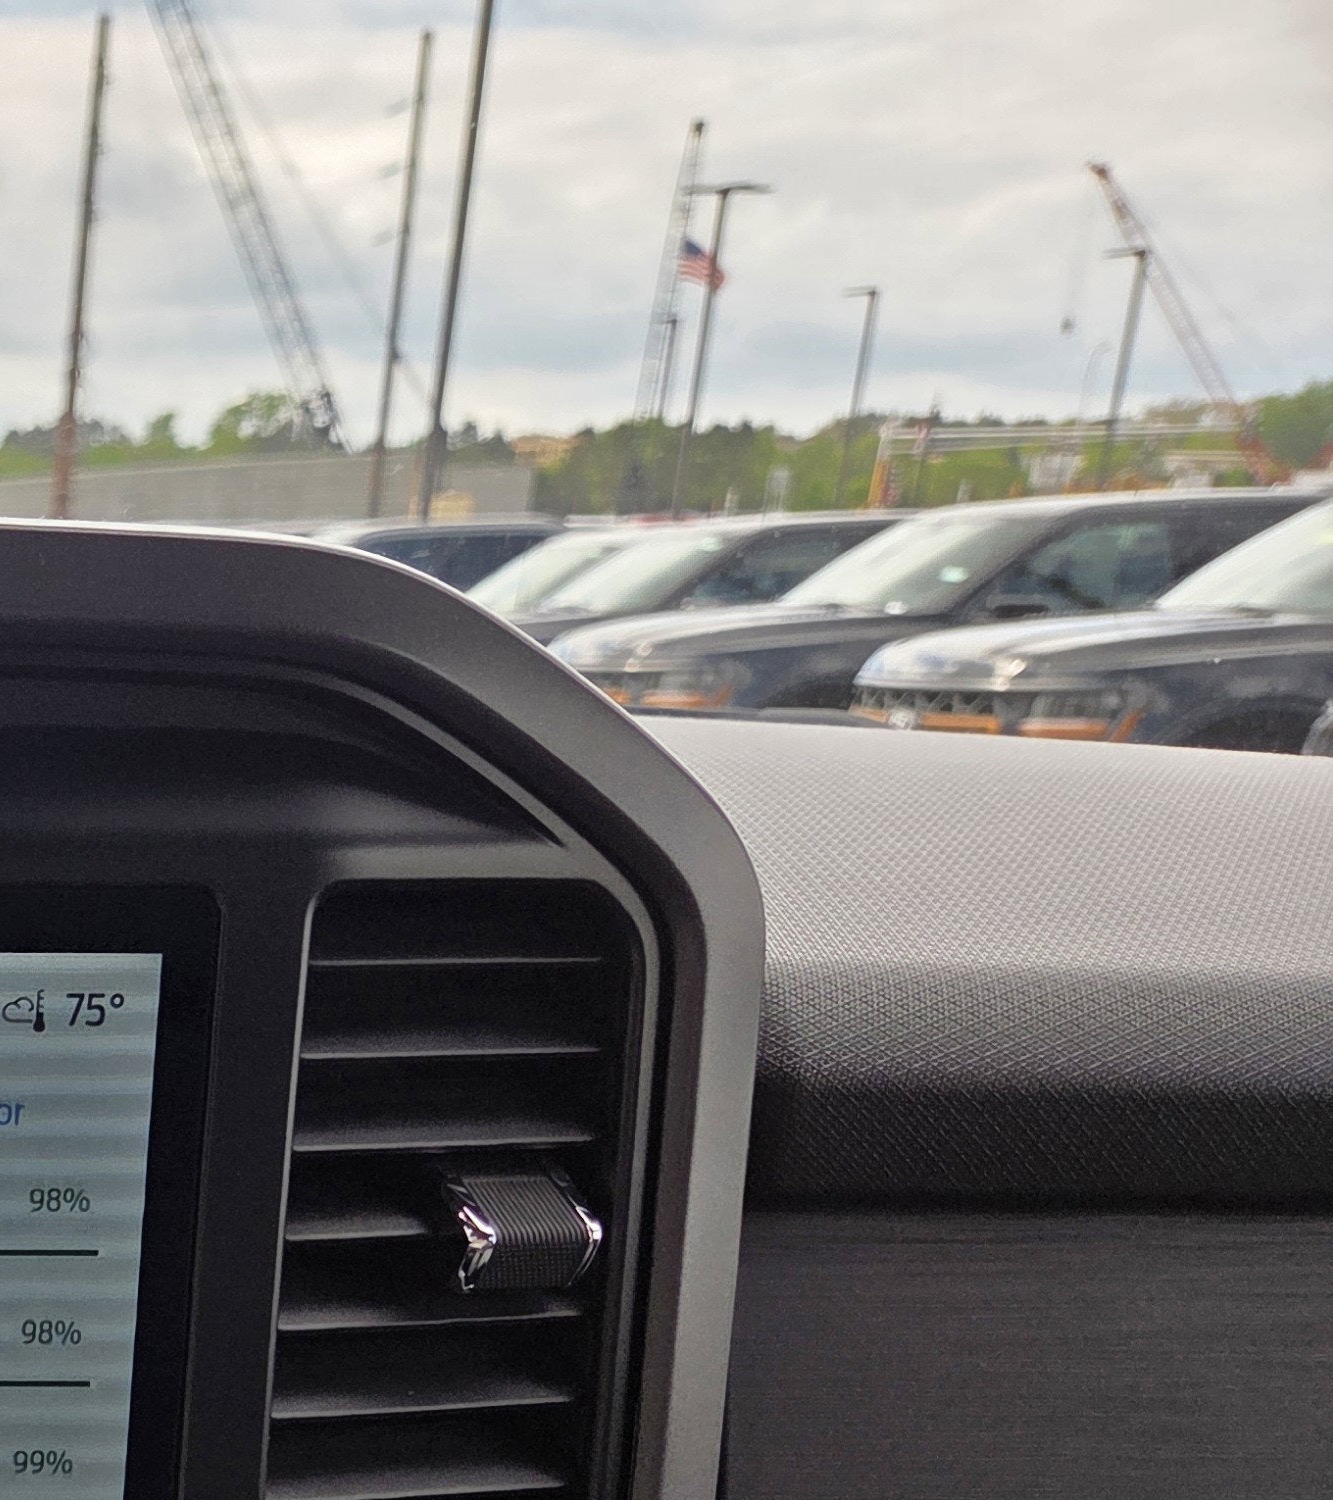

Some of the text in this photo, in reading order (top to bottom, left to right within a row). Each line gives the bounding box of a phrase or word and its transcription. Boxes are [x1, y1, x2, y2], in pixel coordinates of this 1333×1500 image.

[66, 992, 125, 1027] 75°
[29, 1187, 91, 1213] 98%
[21, 1319, 82, 1346] 98%
[13, 1449, 74, 1475] 99%
